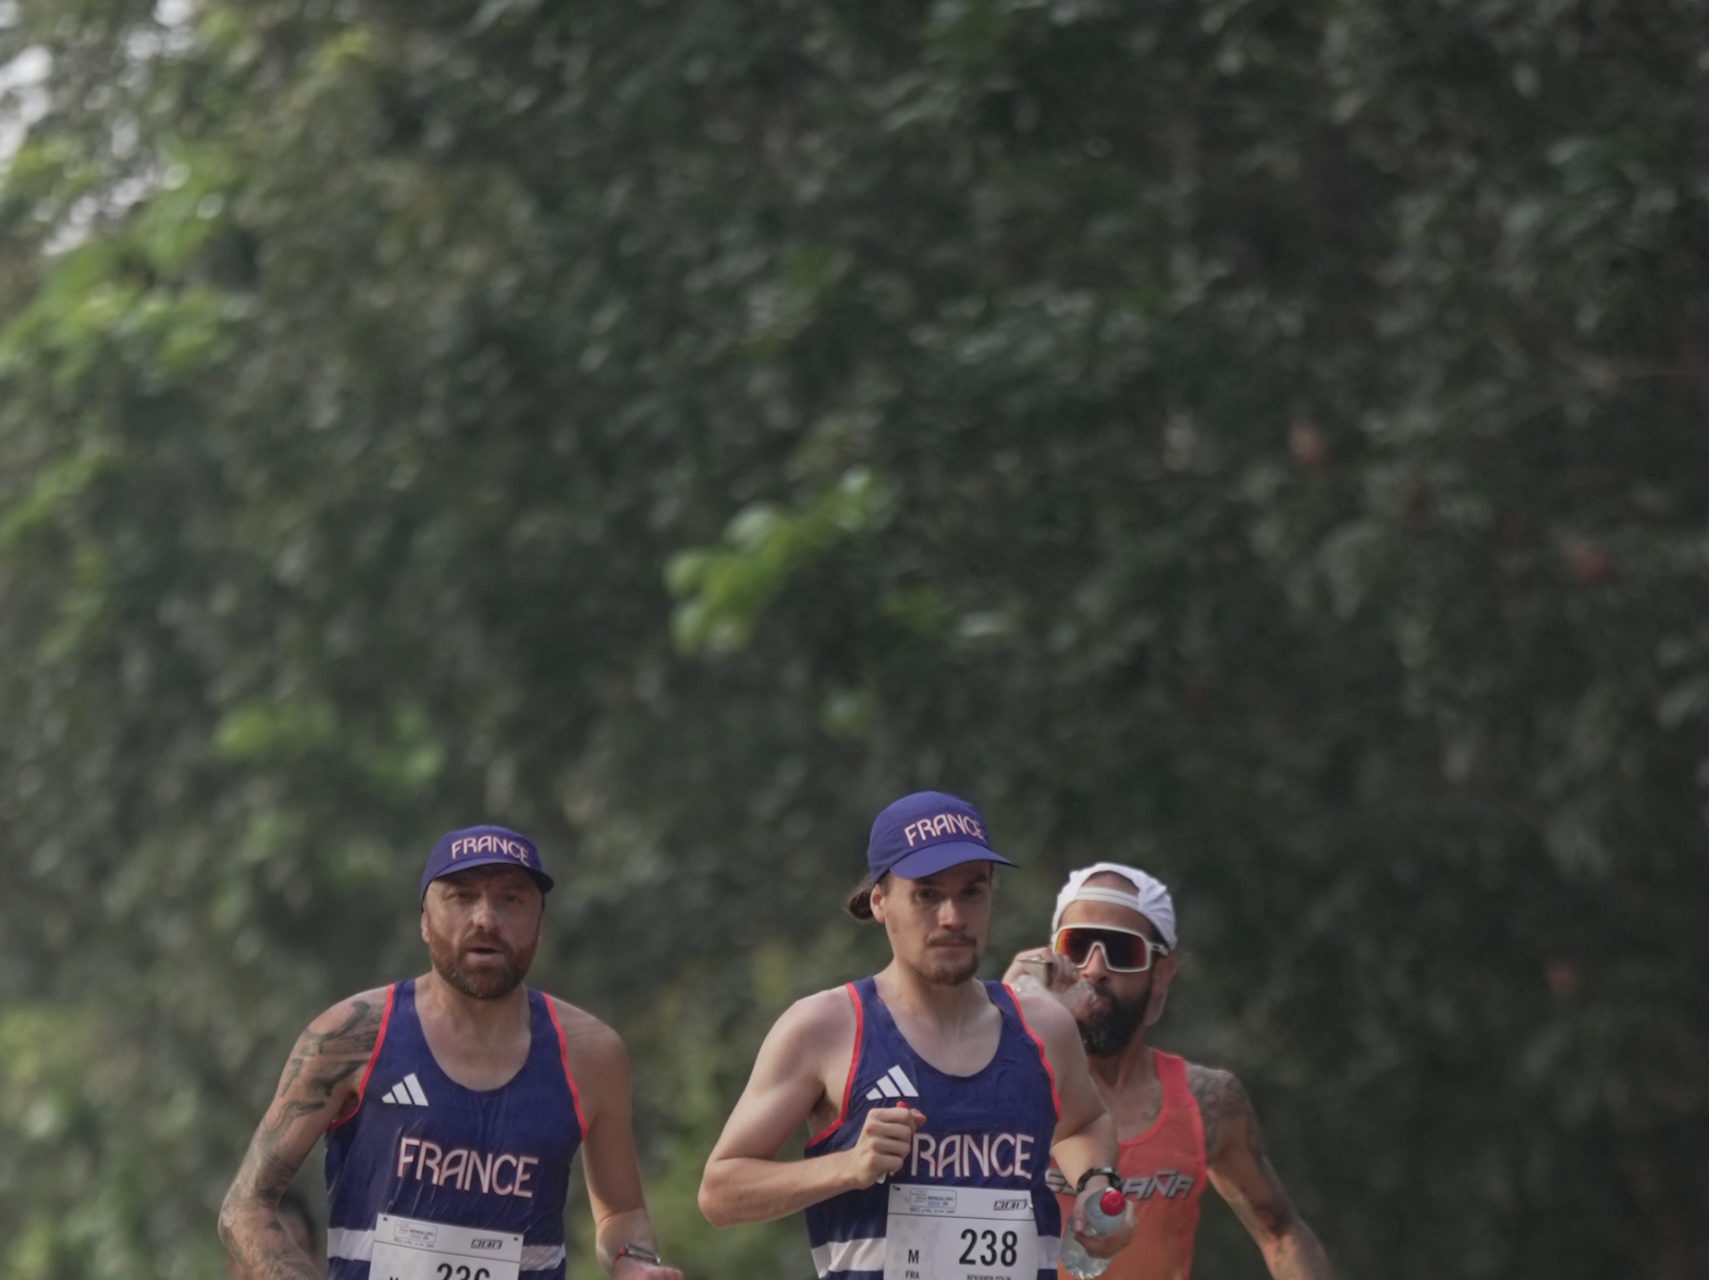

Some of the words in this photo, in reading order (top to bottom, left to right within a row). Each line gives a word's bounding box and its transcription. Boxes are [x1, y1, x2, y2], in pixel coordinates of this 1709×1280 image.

[451, 835, 530, 867] FRANCE
[397, 1137, 539, 1198] FRANCE
[910, 1132, 1035, 1180] RANCE
[1045, 1168, 1194, 1200] EAÑA
[908, 1249, 919, 1264] M
[959, 1228, 1018, 1267] 238
[905, 1270, 920, 1280] FRA
